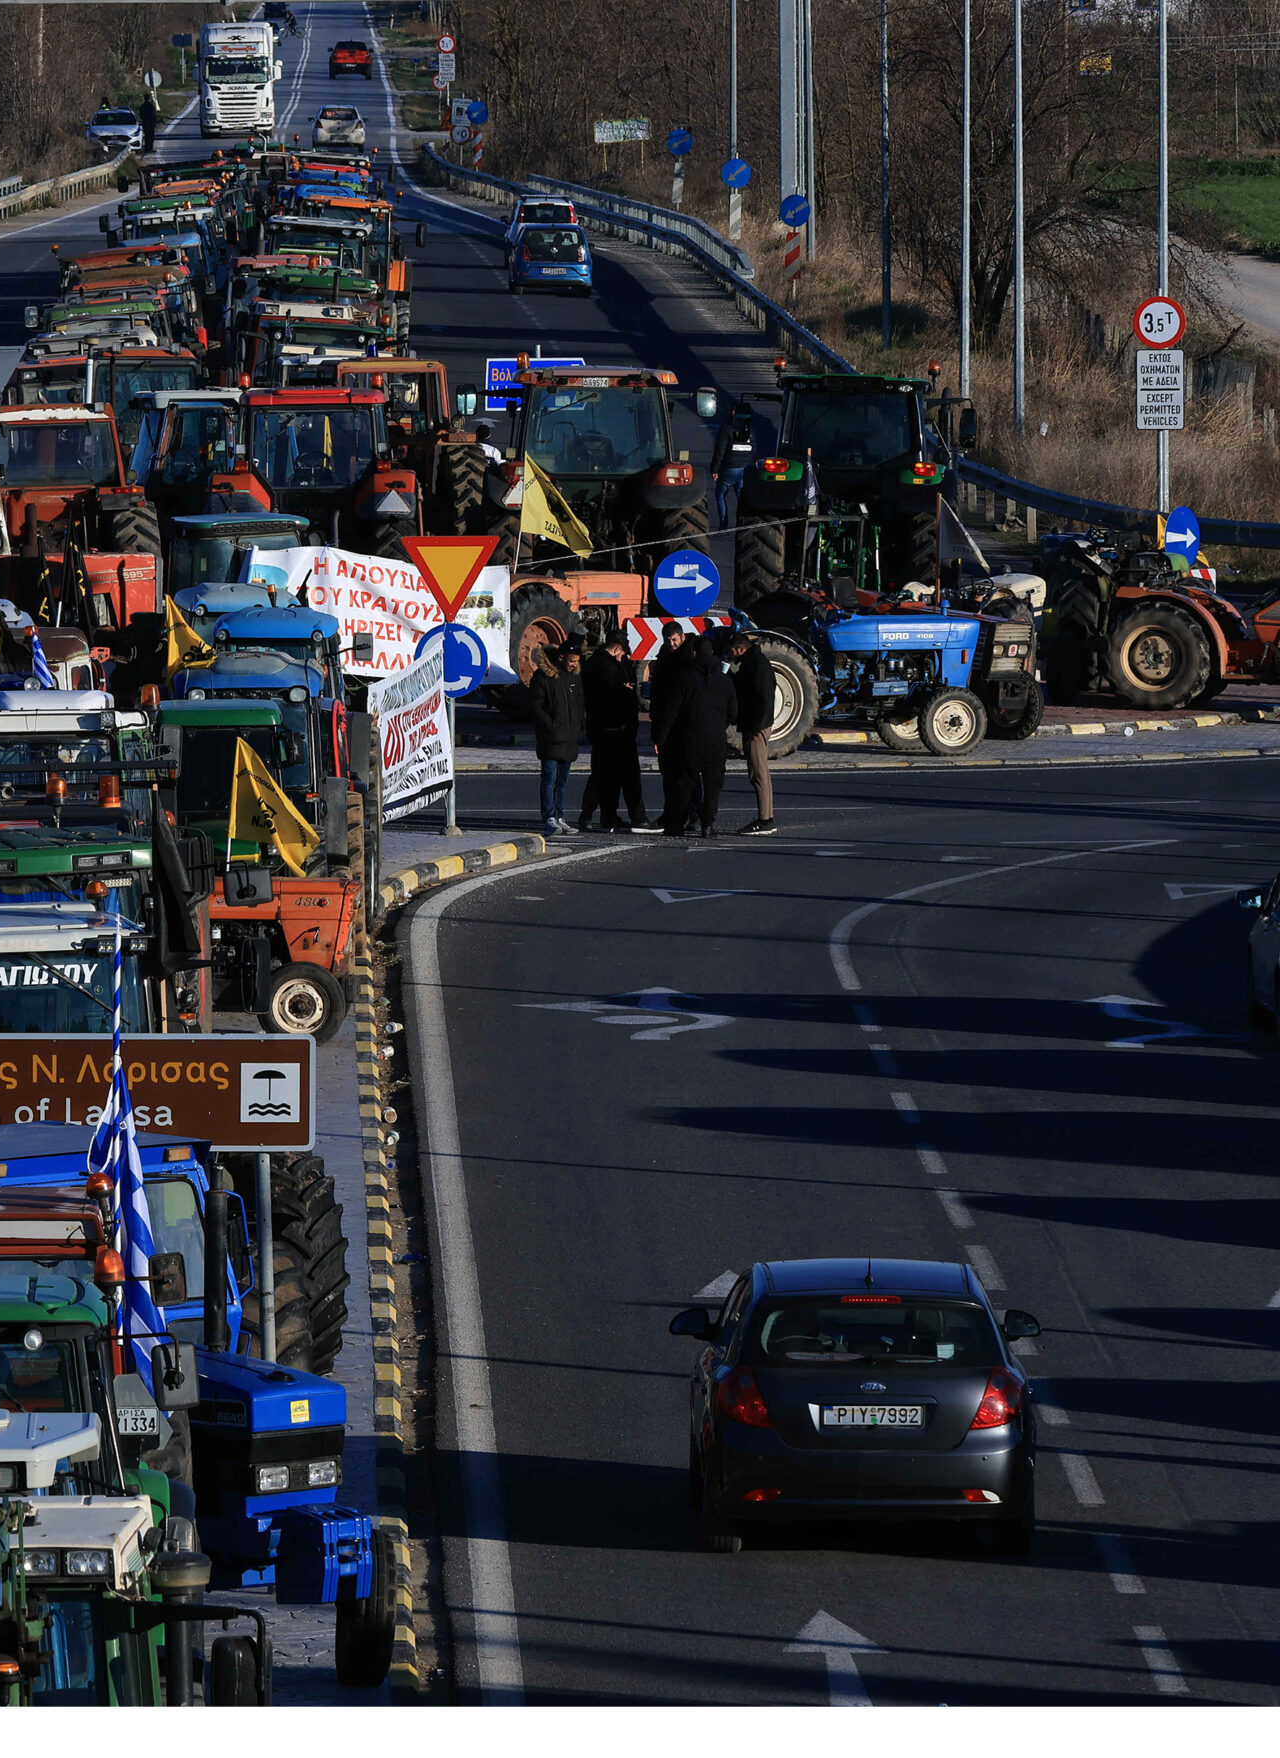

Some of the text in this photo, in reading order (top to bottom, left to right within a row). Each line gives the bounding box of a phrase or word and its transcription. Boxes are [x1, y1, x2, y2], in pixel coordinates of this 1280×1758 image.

[1149, 354, 1171, 362] ΕΚΤΟΣ
[492, 368, 517, 381] Βόλ
[1140, 365, 1180, 374] ΟΧΗΜΑΤΩΝ
[1142, 377, 1178, 386] ΜΕ ΑΔΕΙΑ
[1147, 394, 1174, 402] EXCEPT
[1140, 405, 1180, 415] PERMITTED
[1143, 416, 1178, 426] VEHICLES
[314, 556, 431, 594] Η ΑΠΟΥΣΙΑ
[32, 1055, 65, 1083] Ν.
[14, 1097, 51, 1125] of
[66, 1097, 173, 1127] Lasa
